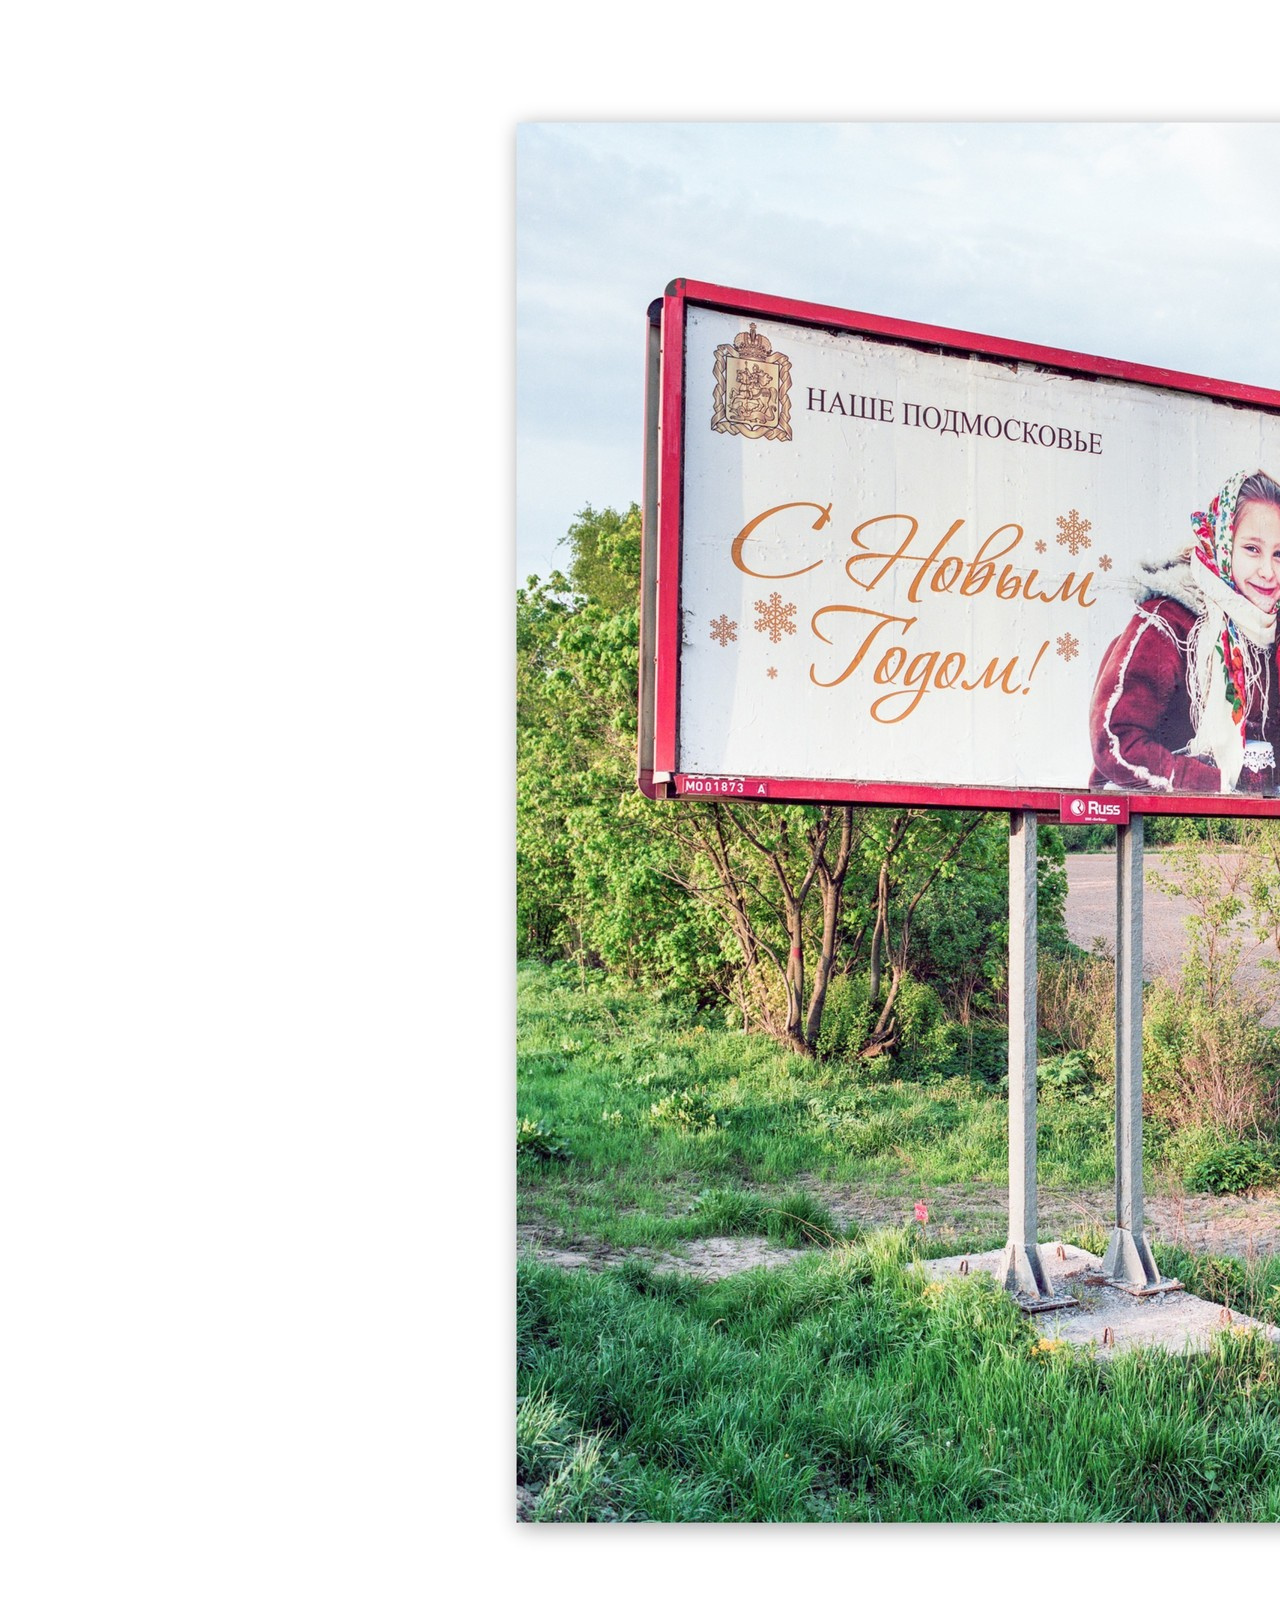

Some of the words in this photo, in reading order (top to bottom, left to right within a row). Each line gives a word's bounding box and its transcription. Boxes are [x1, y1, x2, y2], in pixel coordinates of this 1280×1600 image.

[806, 387, 895, 423] НАШЕ
[902, 403, 1104, 455] ПОДМОСКОВЬЕ
[730, 502, 833, 579] С
[845, 513, 1098, 608] Новым
[809, 604, 1051, 724] Годом!
[1088, 800, 1121, 815] Russ
